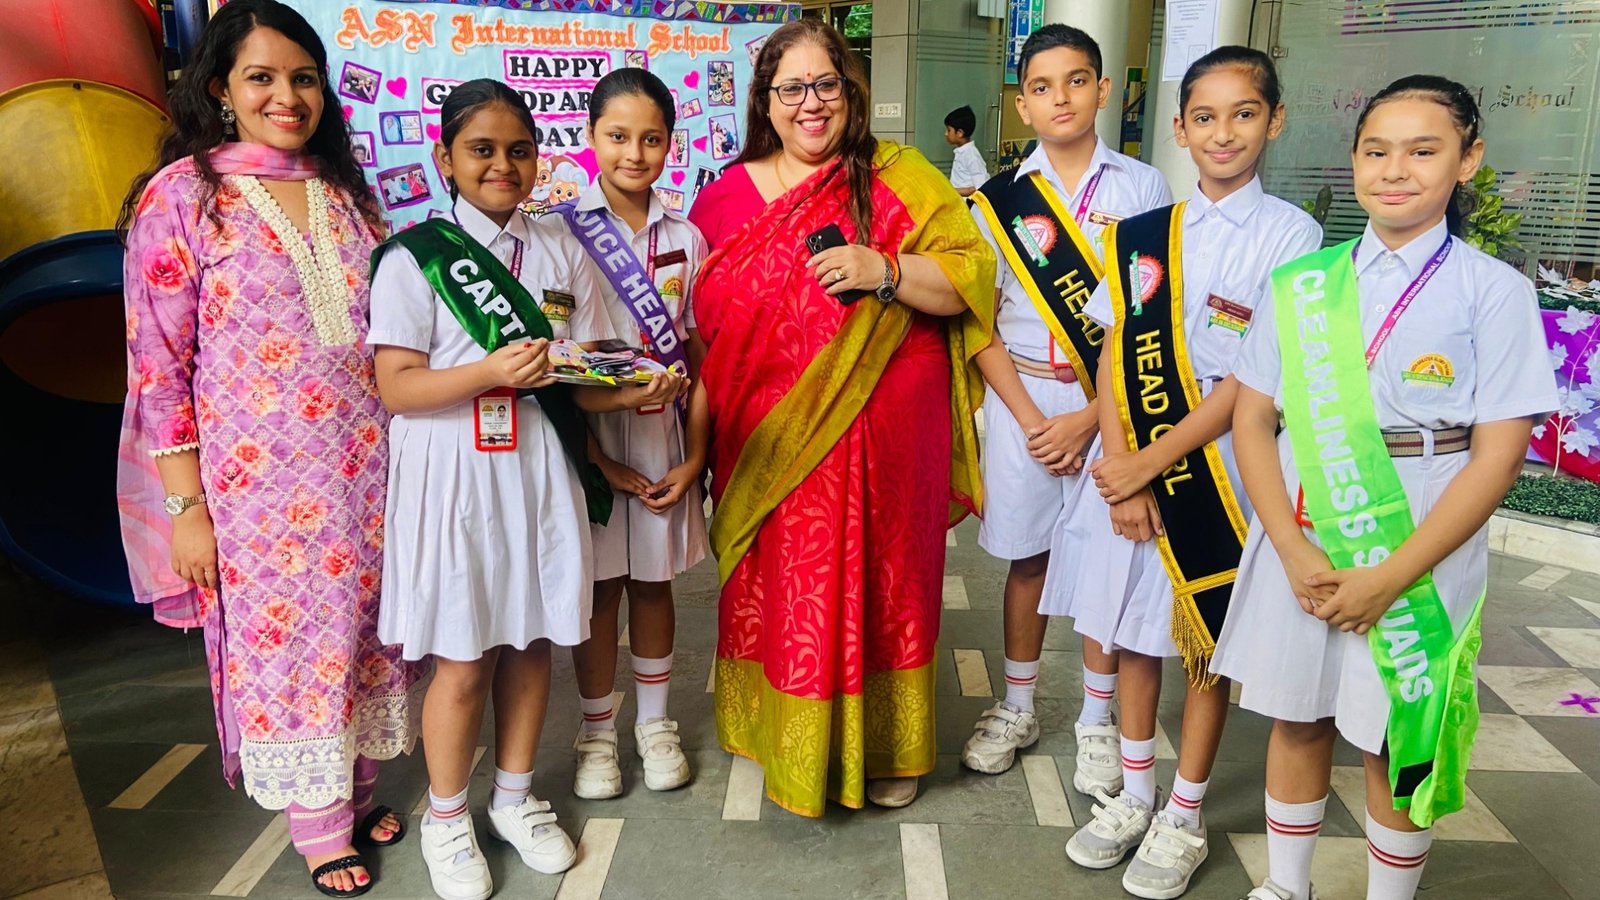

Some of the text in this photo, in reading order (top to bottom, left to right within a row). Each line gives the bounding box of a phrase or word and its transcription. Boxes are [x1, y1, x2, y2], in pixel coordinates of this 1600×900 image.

[336, 7, 731, 58] ASN International School
[509, 56, 606, 78] HAPPY
[450, 258, 532, 345] CAPT
[575, 211, 678, 354] VICE HEAD
[1053, 269, 1105, 347] HEAD
[1403, 261, 1439, 309] INTERNATIONAL
[1371, 326, 1391, 354] SCHOOL
[1135, 329, 1192, 496] HEAD GRL
[1293, 269, 1433, 703] CLEANLINESS SUADS
